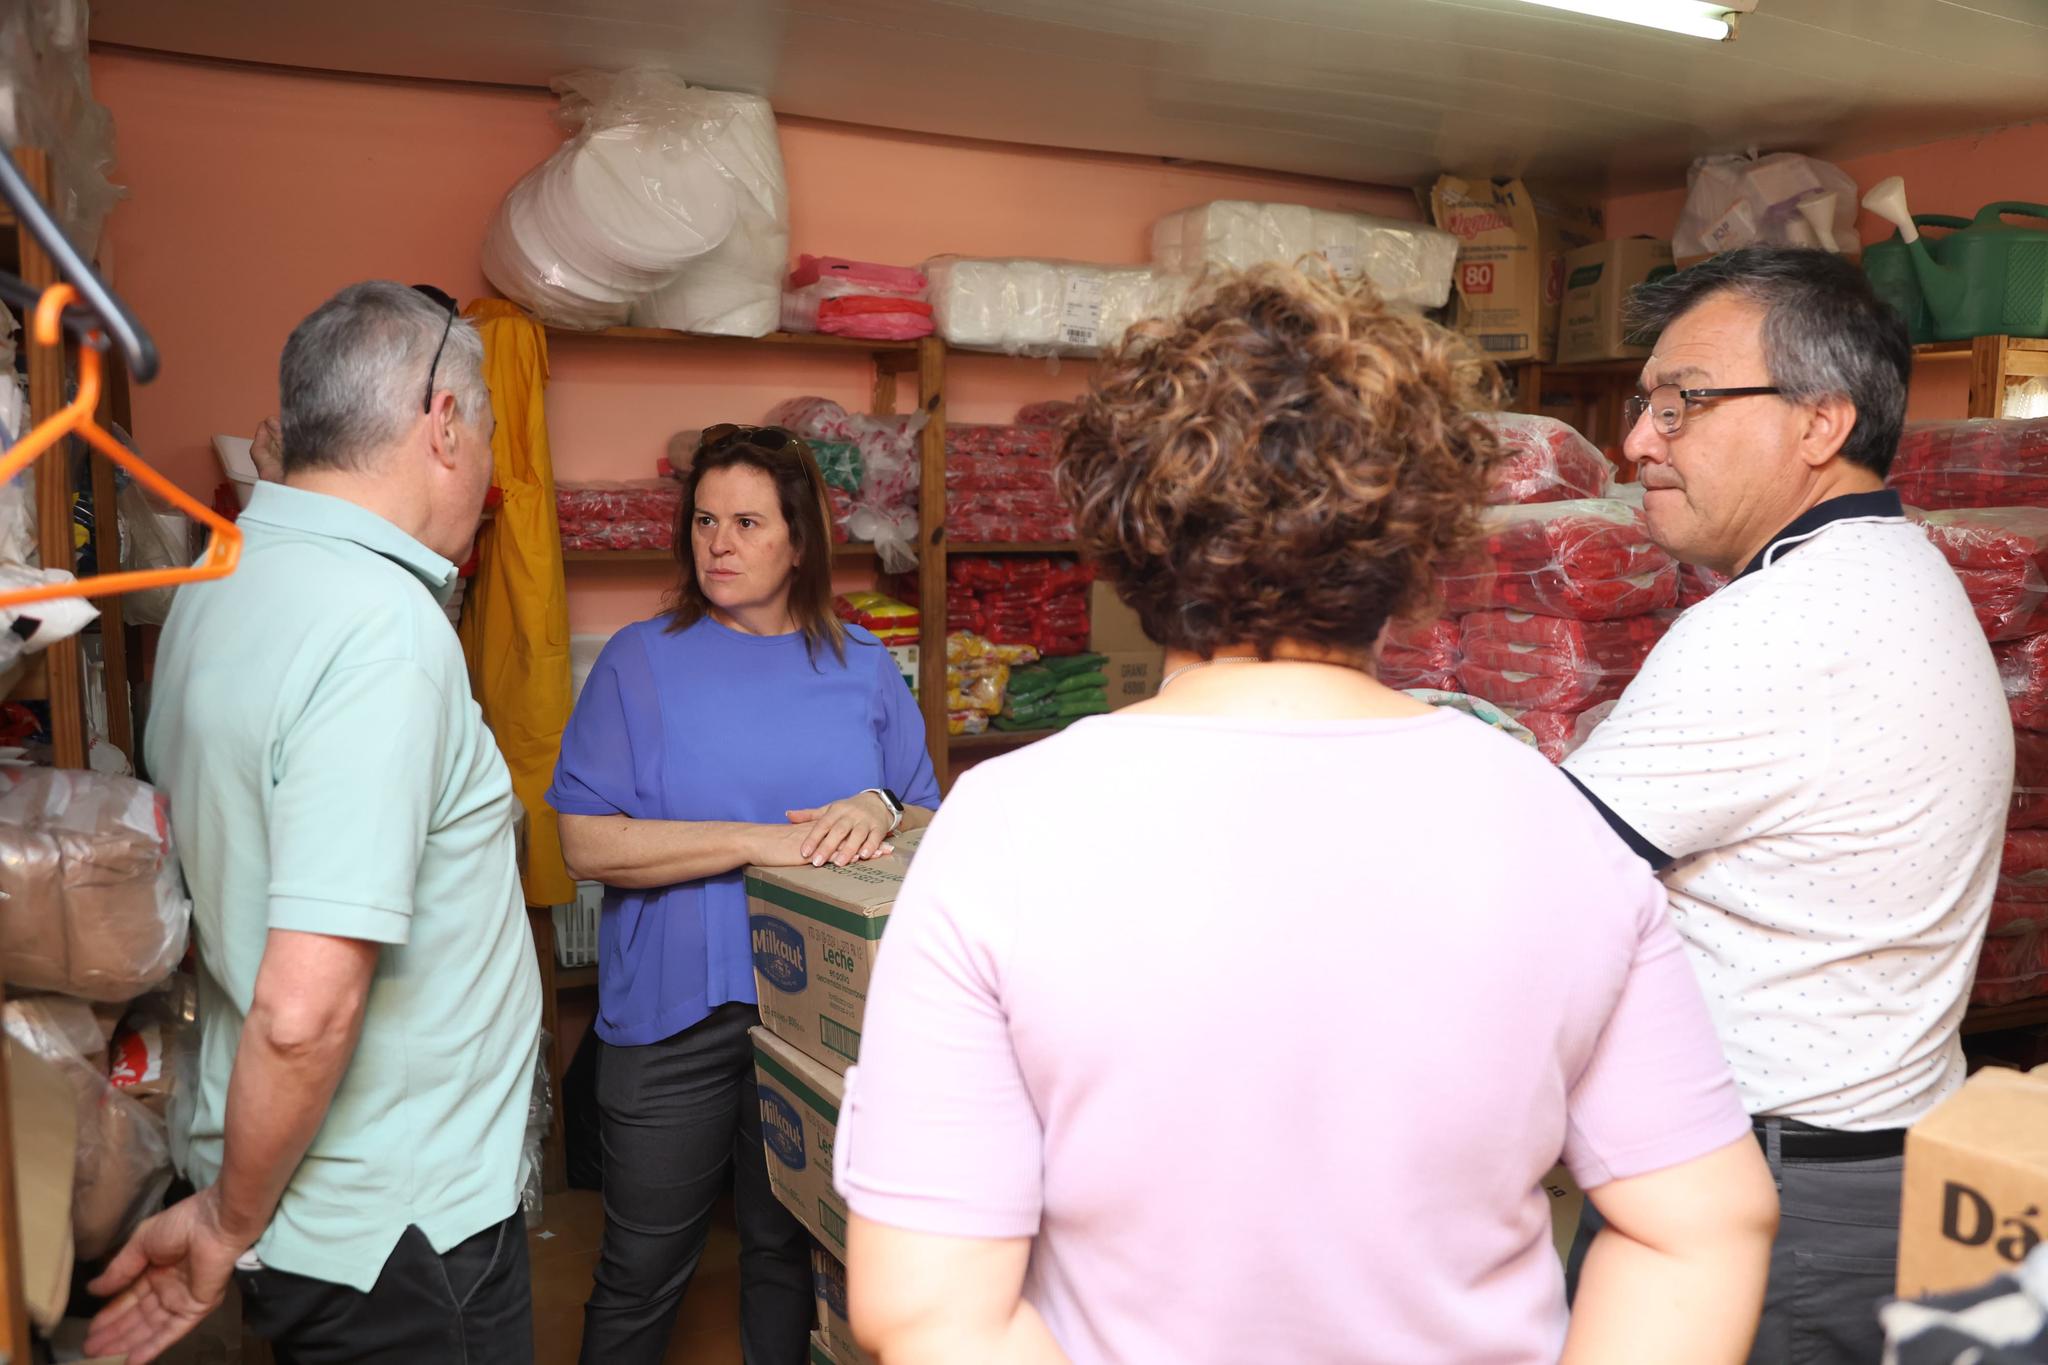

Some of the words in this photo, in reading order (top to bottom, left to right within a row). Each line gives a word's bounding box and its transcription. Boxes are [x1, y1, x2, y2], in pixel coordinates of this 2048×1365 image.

[1465, 266, 1491, 285] 80
[752, 928, 804, 973] Milkaut
[822, 943, 855, 973] Leche
[759, 1098, 803, 1153] Milkaut
